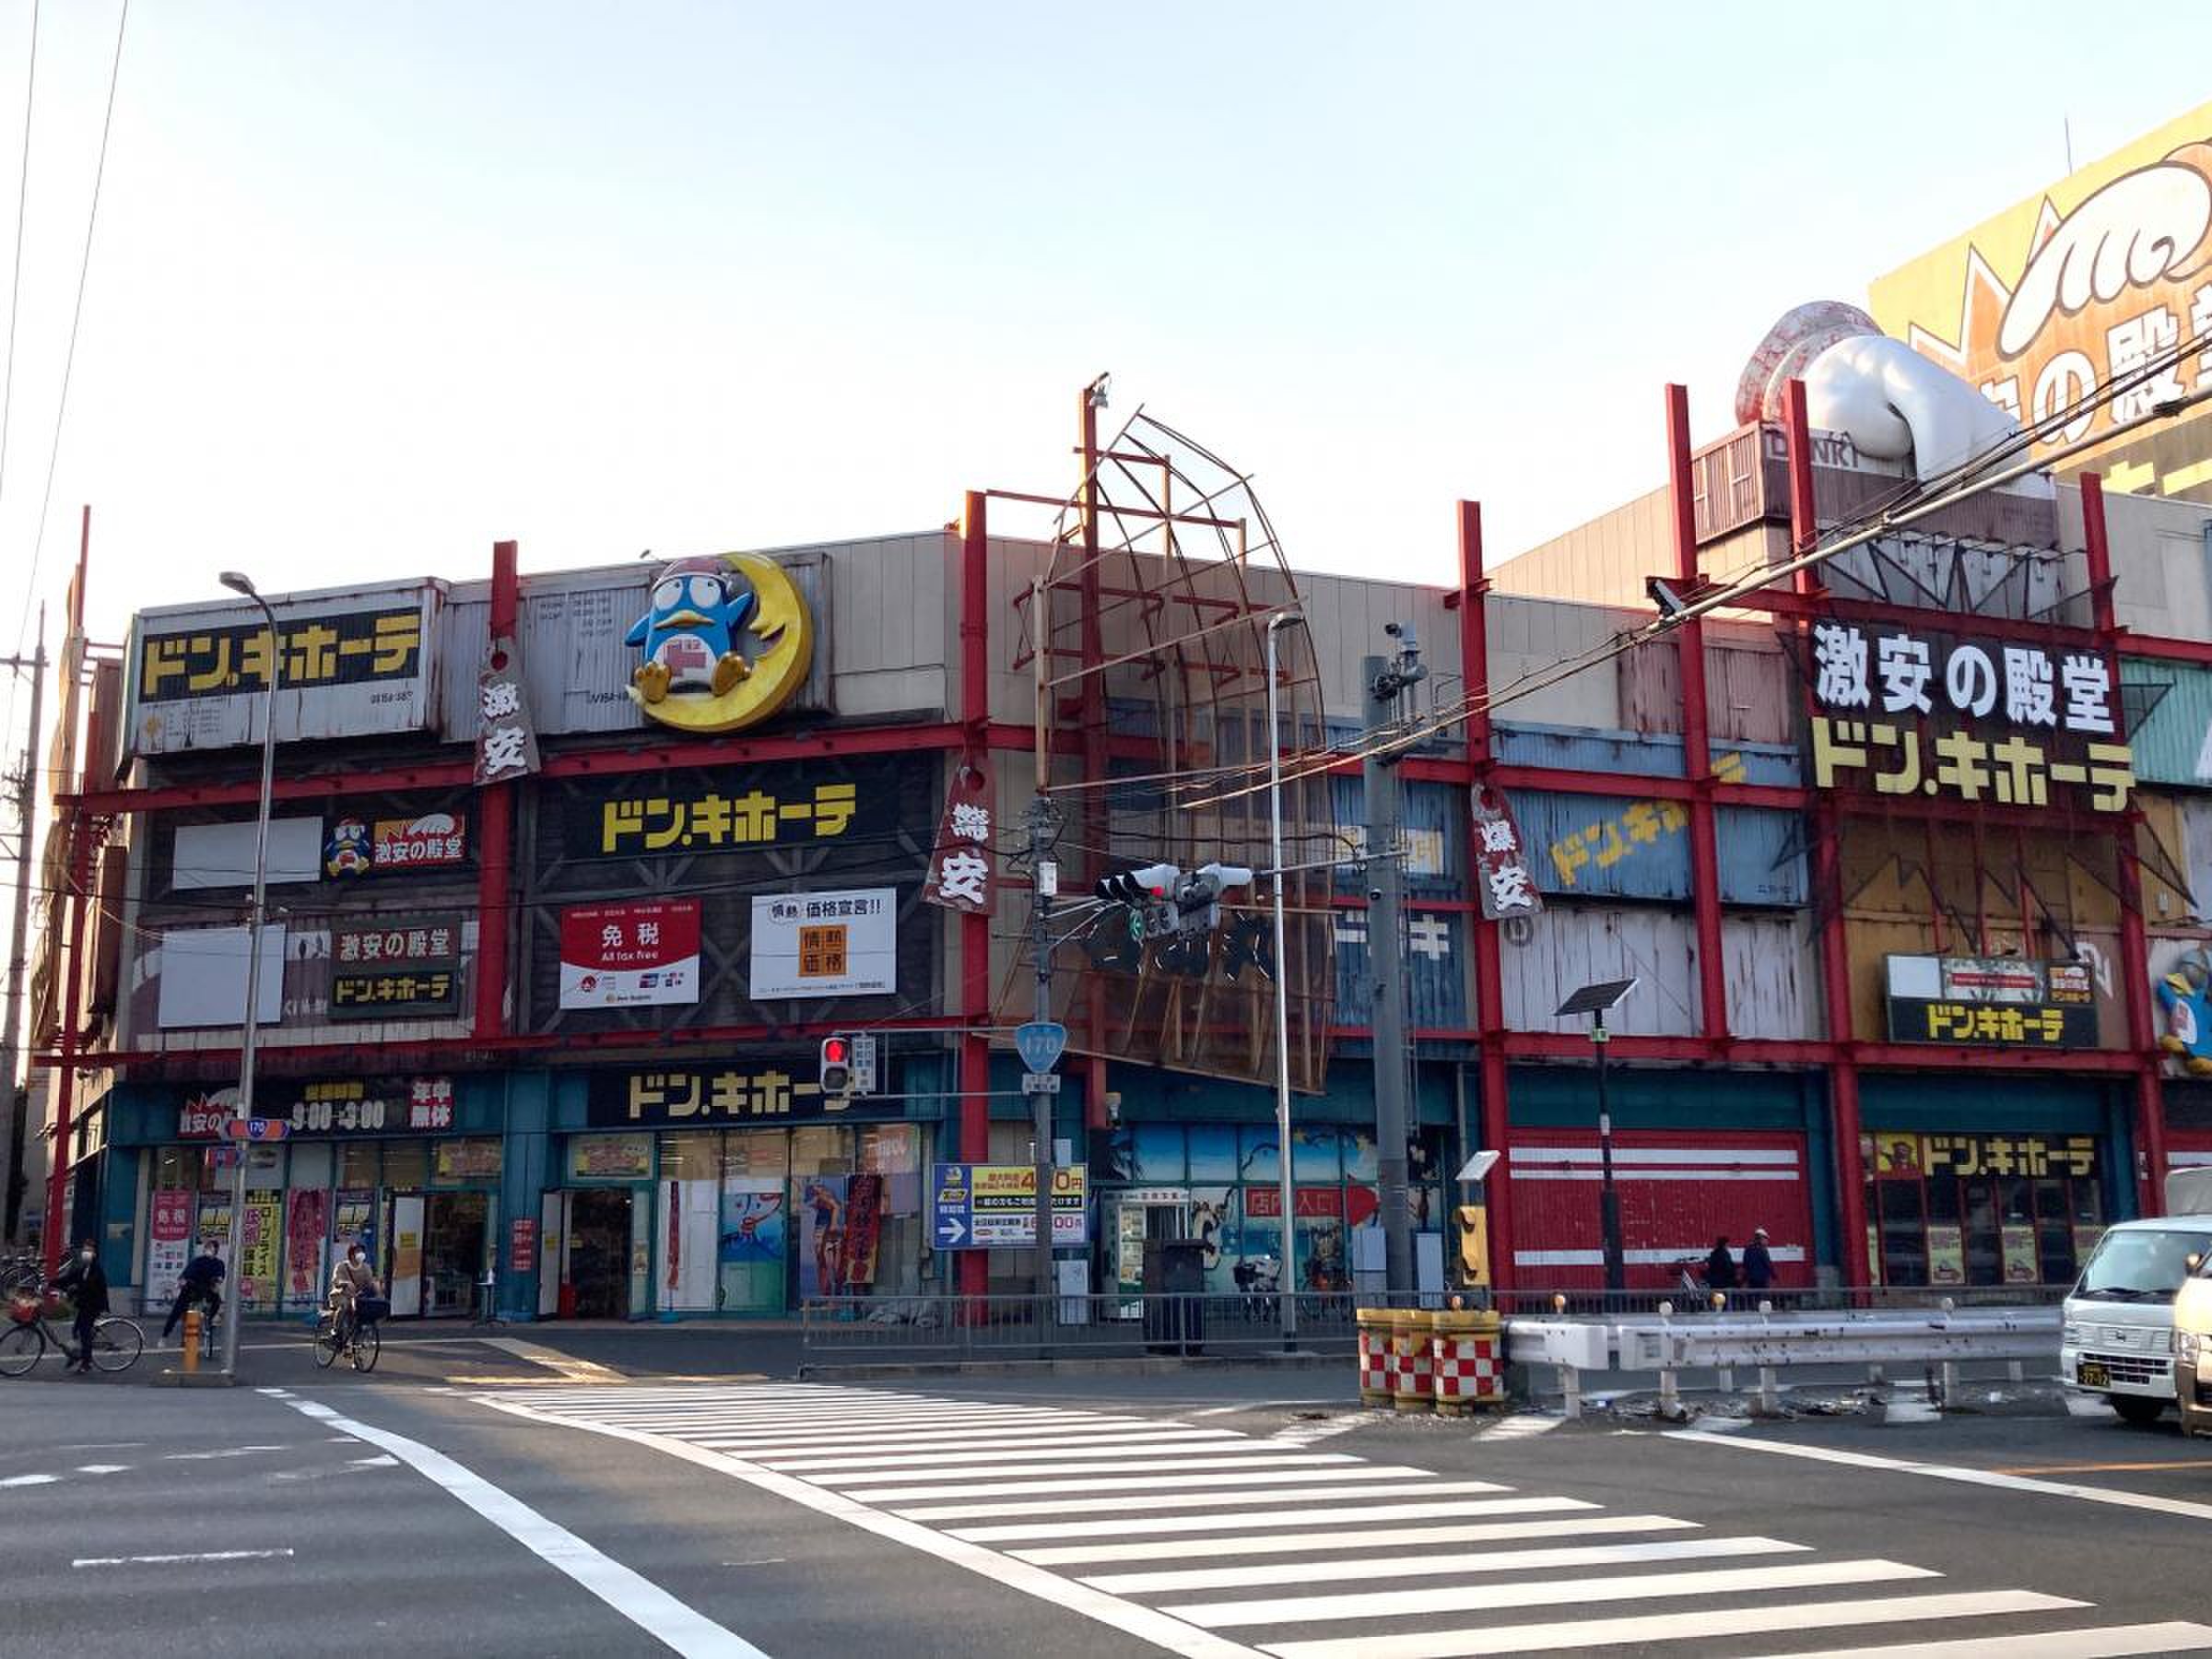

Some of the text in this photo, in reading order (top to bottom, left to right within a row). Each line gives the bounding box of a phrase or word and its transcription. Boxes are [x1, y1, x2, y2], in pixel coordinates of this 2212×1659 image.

[1814, 625, 2114, 734] 激安の殿堂
[340, 929, 450, 960] 激安の殿堂
[602, 923, 659, 947] 免税
